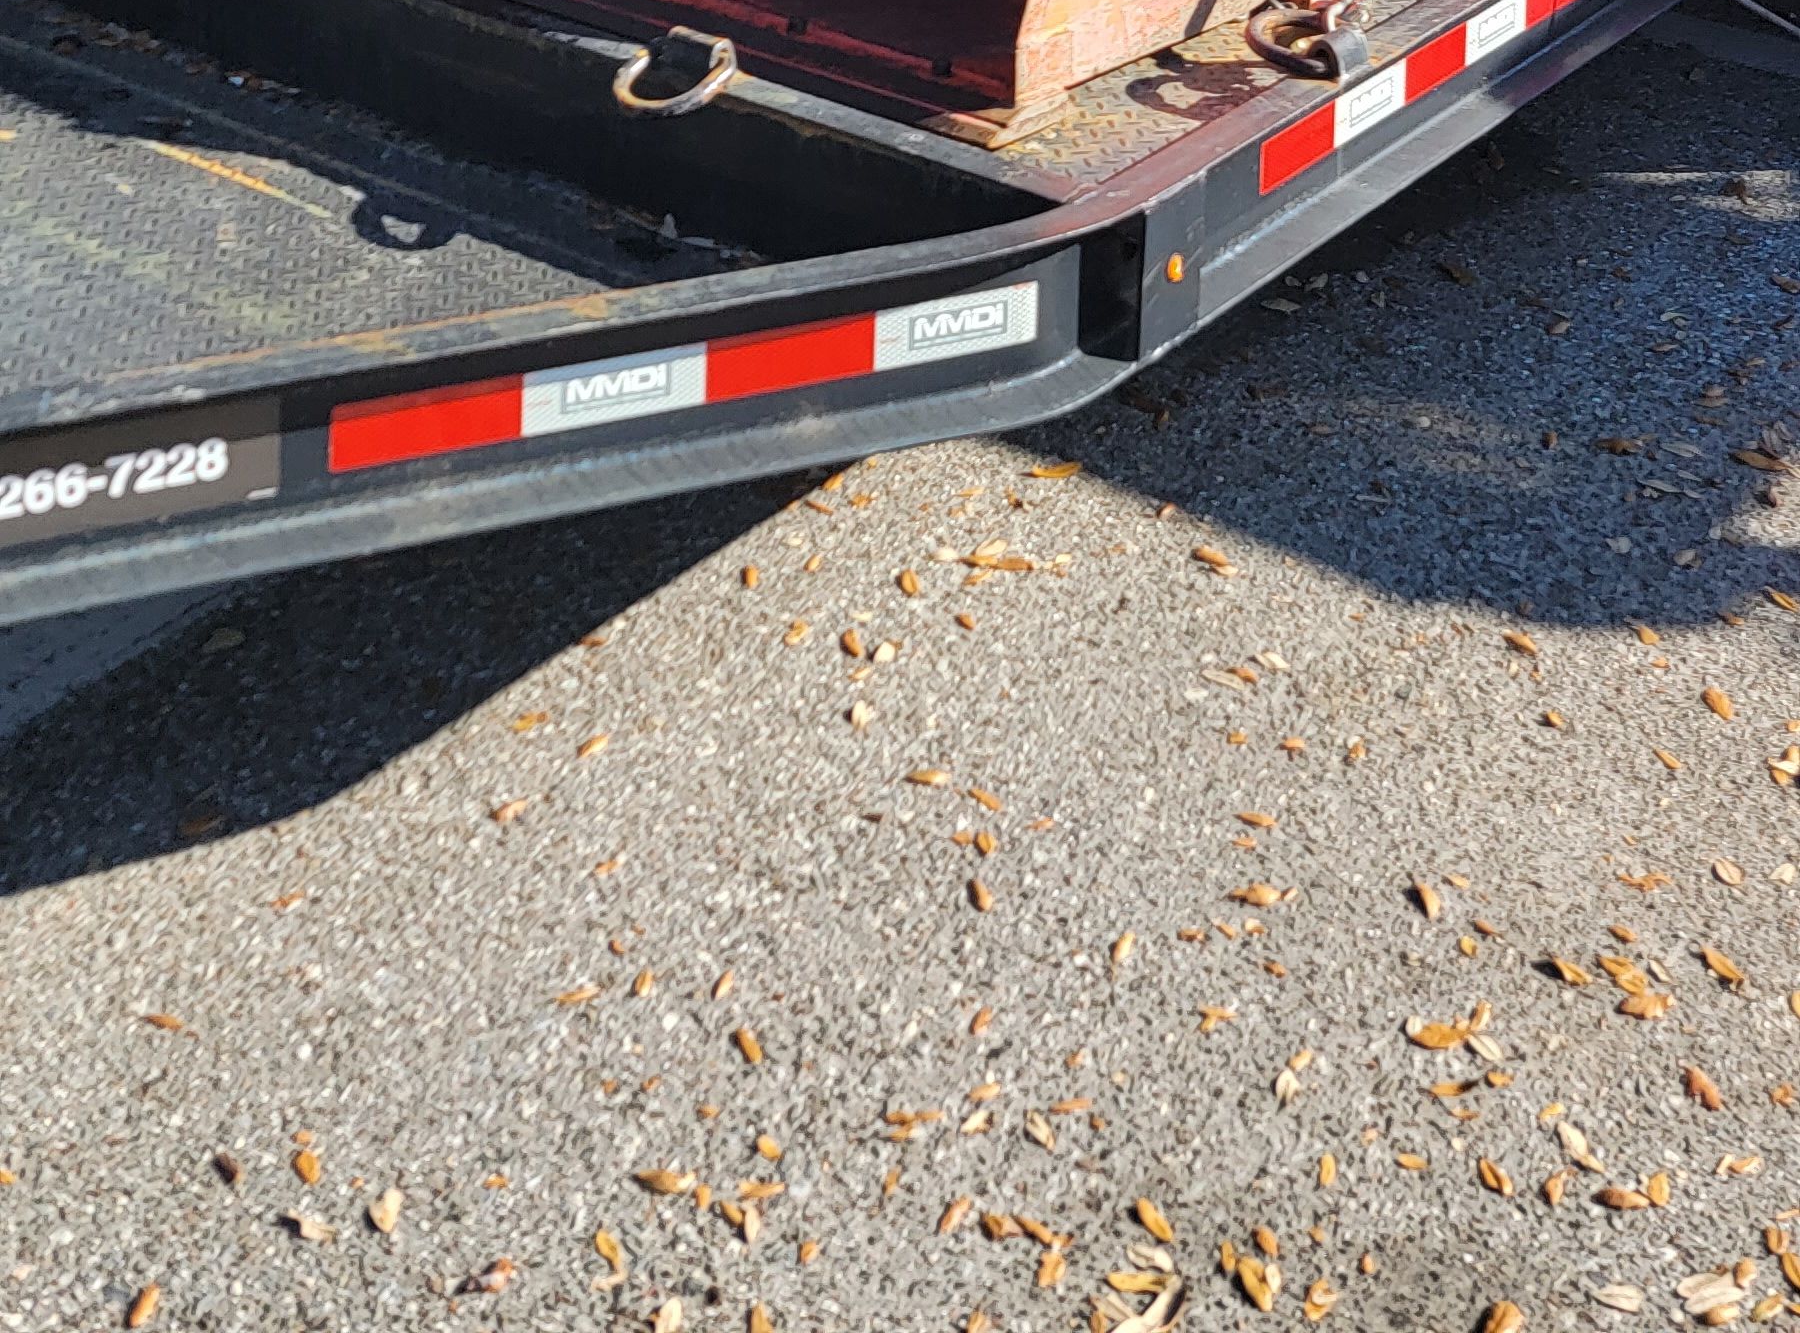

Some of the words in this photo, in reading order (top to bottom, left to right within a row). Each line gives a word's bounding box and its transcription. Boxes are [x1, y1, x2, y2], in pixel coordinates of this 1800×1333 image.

[913, 302, 1005, 340] MMDI
[565, 363, 669, 405] MMDI
[0, 437, 229, 521] 266-7228
